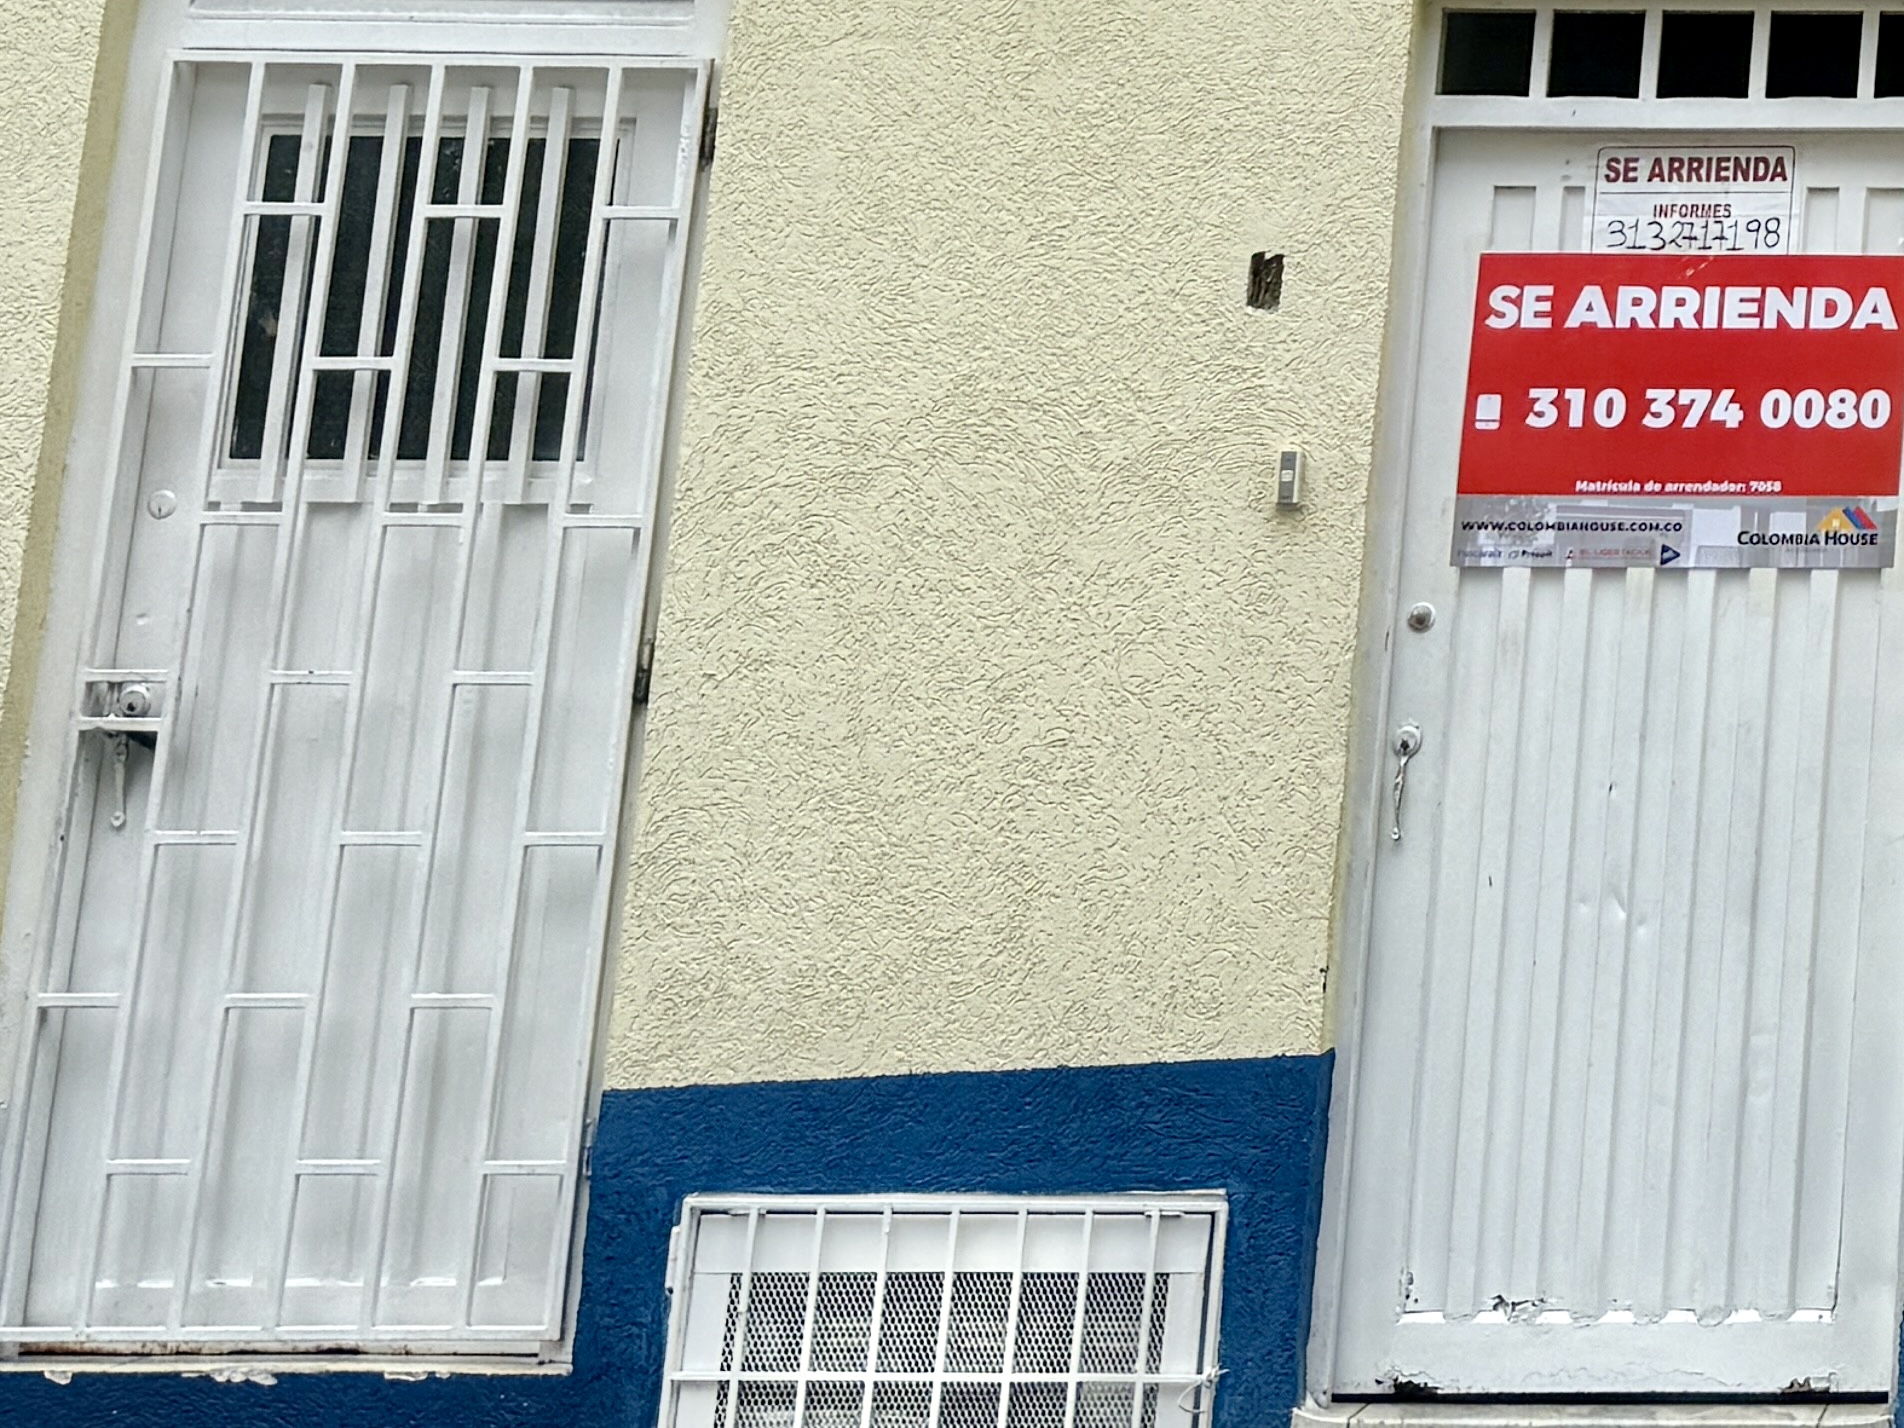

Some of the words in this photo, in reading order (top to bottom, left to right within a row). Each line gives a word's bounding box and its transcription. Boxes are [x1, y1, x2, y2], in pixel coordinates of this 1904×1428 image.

[1604, 157, 1640, 183] SE
[1647, 156, 1788, 183] ARRIENDA
[1653, 204, 1732, 219] INFORMES
[1485, 285, 1554, 330] SE
[1564, 285, 1898, 331] ARRIENDA
[1525, 387, 1626, 428] 310
[1642, 388, 1743, 429] 374
[1760, 388, 1891, 429] 0080
[1644, 480, 1661, 493] de
[1737, 530, 1820, 546] COLOMBIA
[1824, 530, 1878, 546] HOUSE
